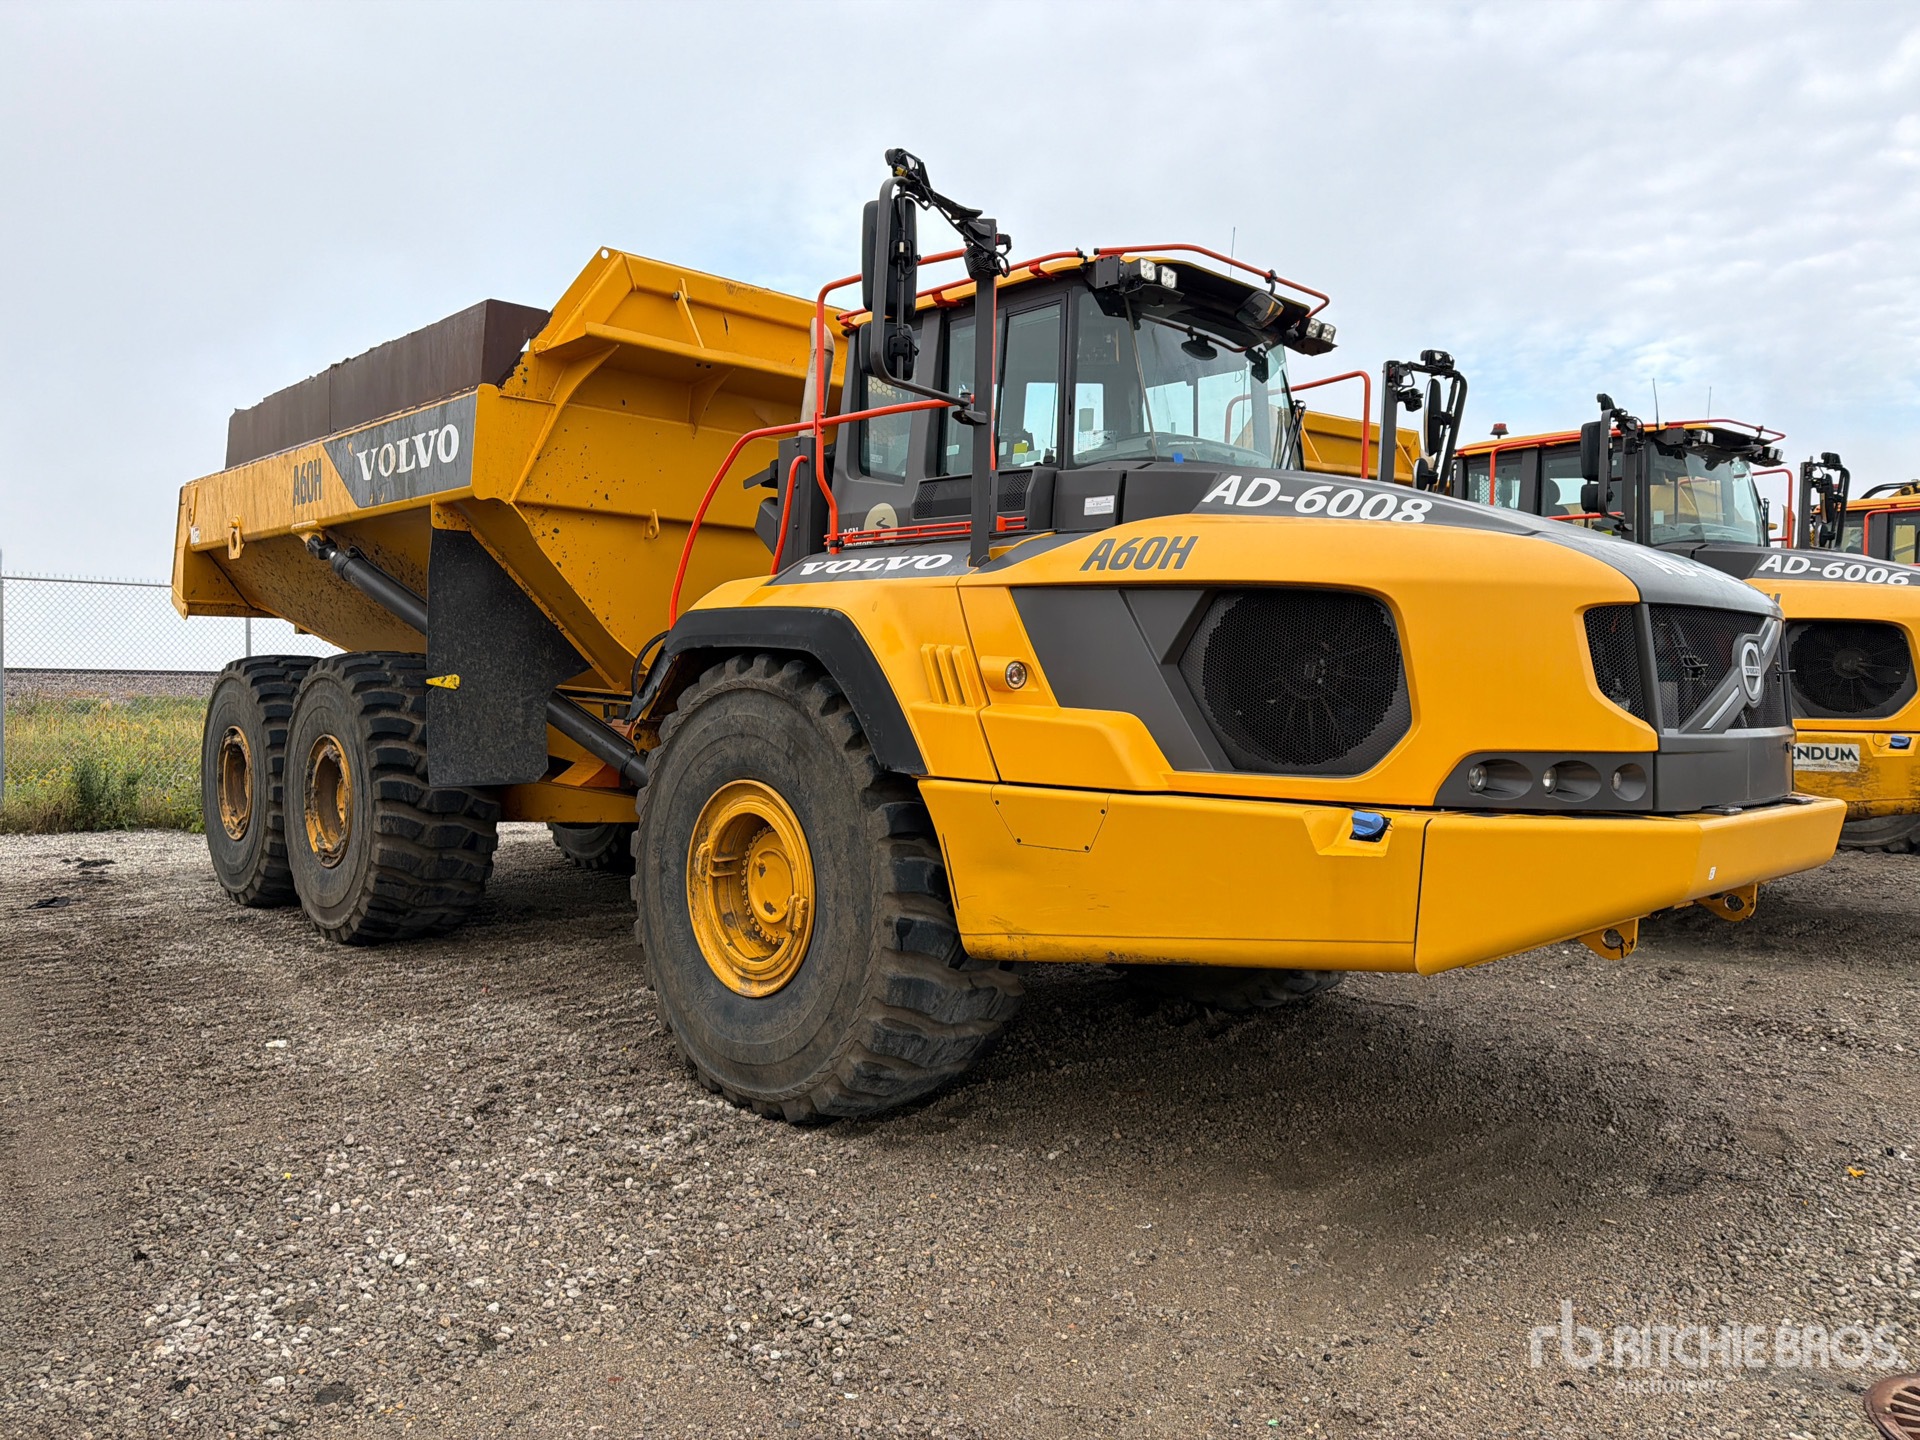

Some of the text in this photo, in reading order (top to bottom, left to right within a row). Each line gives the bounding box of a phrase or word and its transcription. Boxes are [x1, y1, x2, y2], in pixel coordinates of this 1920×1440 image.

[356, 424, 460, 481] VOLVO
[293, 458, 322, 506] A60H
[1202, 474, 1433, 523] AD-6008
[800, 554, 953, 576] VOLVO
[1079, 535, 1199, 572] A60H
[1758, 554, 1912, 586] AD-6006
